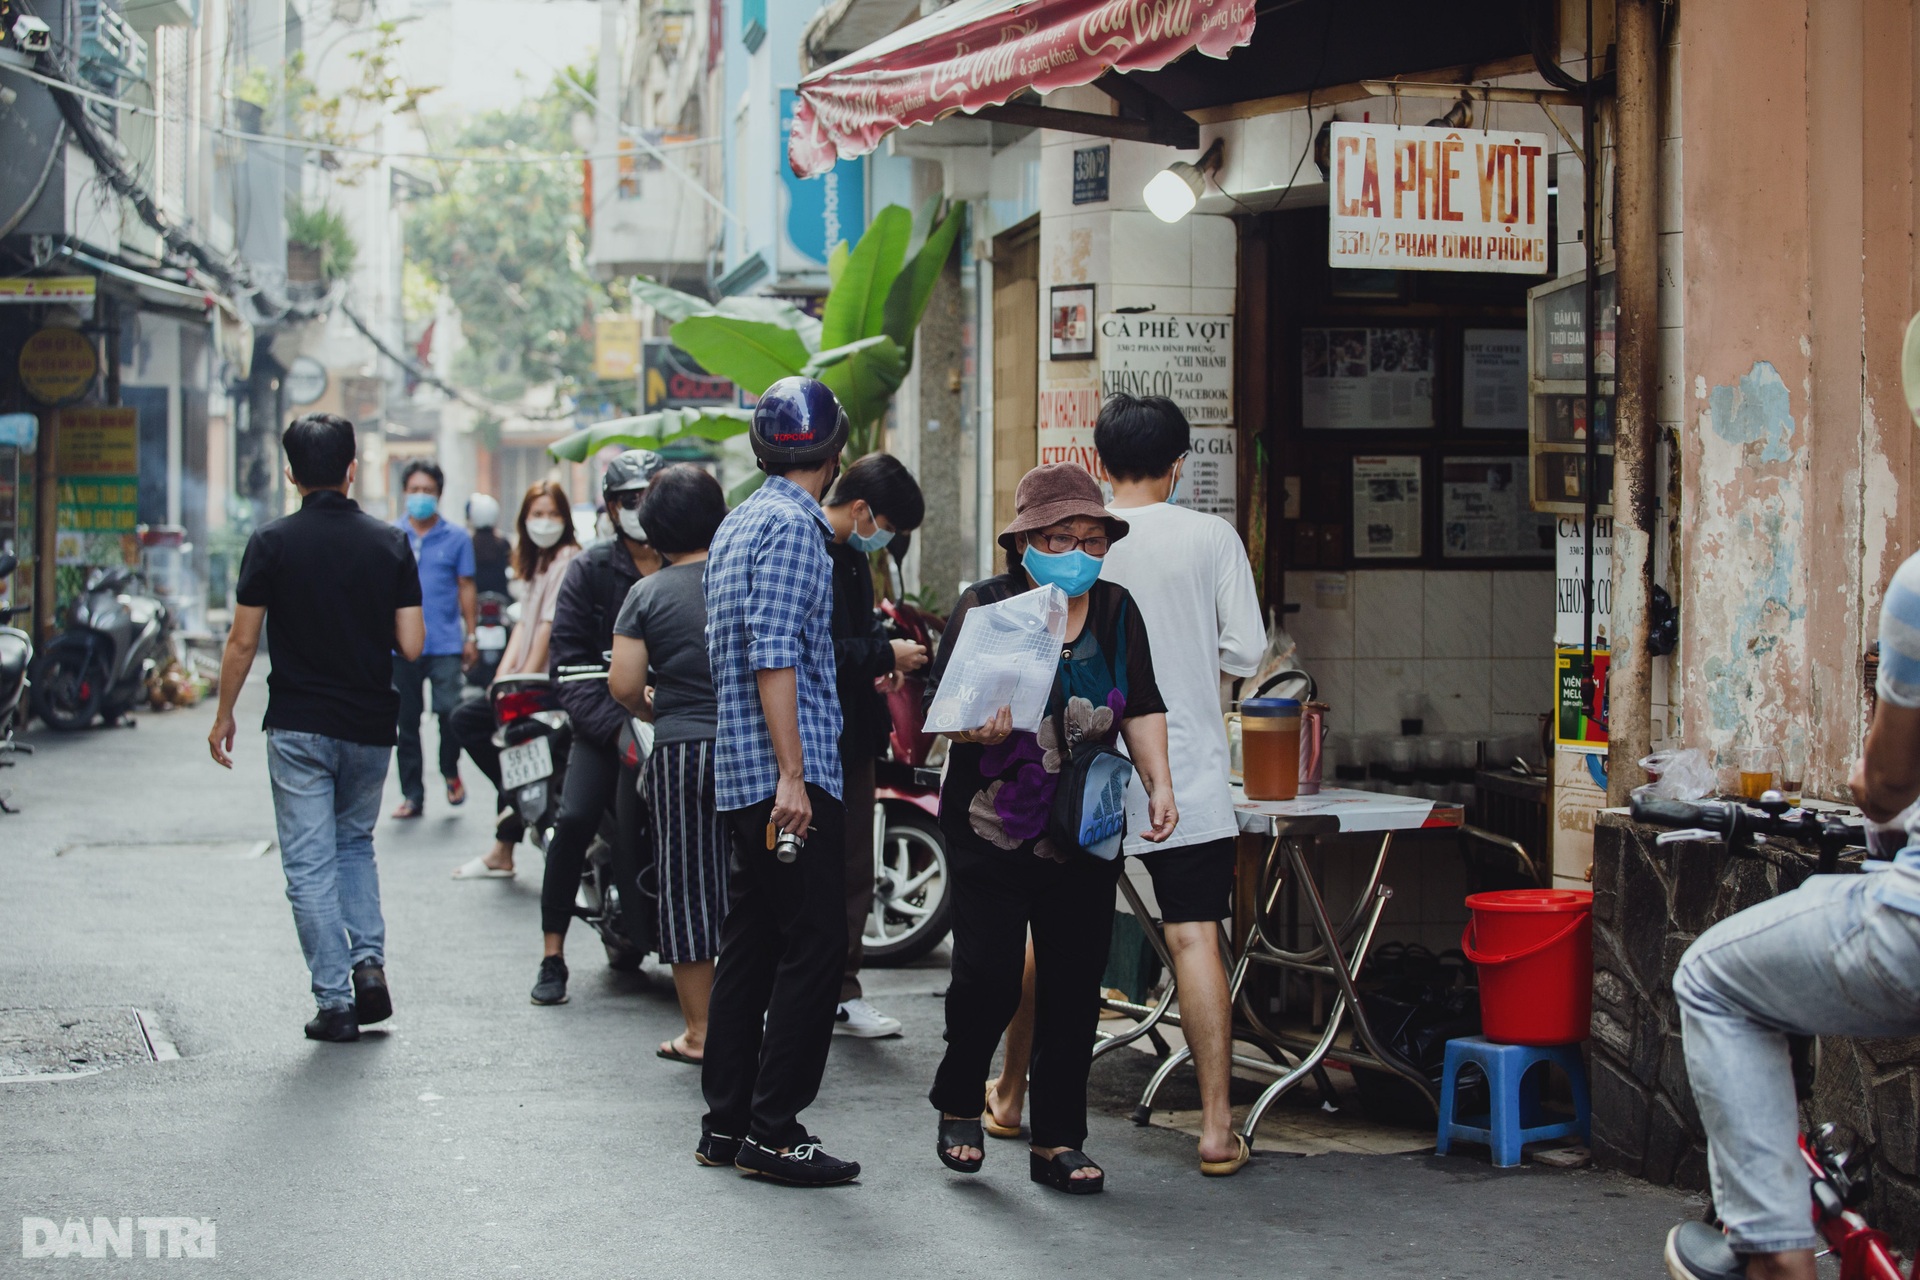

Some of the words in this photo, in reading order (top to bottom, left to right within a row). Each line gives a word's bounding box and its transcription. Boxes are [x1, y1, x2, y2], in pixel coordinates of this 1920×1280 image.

[1028, 53, 1051, 74] sảng
[1049, 43, 1078, 67] khoái
[1394, 132, 1464, 222] PHÊ
[1475, 138, 1542, 233] VỢT
[1336, 226, 1390, 262] 330/2
[1395, 232, 1437, 258] PHAN
[1487, 233, 1544, 263] PHÙNG
[1554, 309, 1571, 328] ĐẬM
[1571, 311, 1581, 328] VỊ
[1102, 316, 1131, 338] CÀ
[1138, 316, 1180, 338] PHÊ
[1185, 321, 1230, 344] VỢT
[1567, 331, 1585, 345] GIAN
[1138, 344, 1161, 352] PHAN
[1102, 360, 1150, 399] KHÔNG
[1153, 360, 1173, 399] CÓ
[774, 431, 814, 443] TOPCOM
[1208, 434, 1233, 455] GIÁ
[1557, 514, 1582, 539] CÀ
[1563, 675, 1582, 688] VIÊN
[954, 684, 980, 705] My
